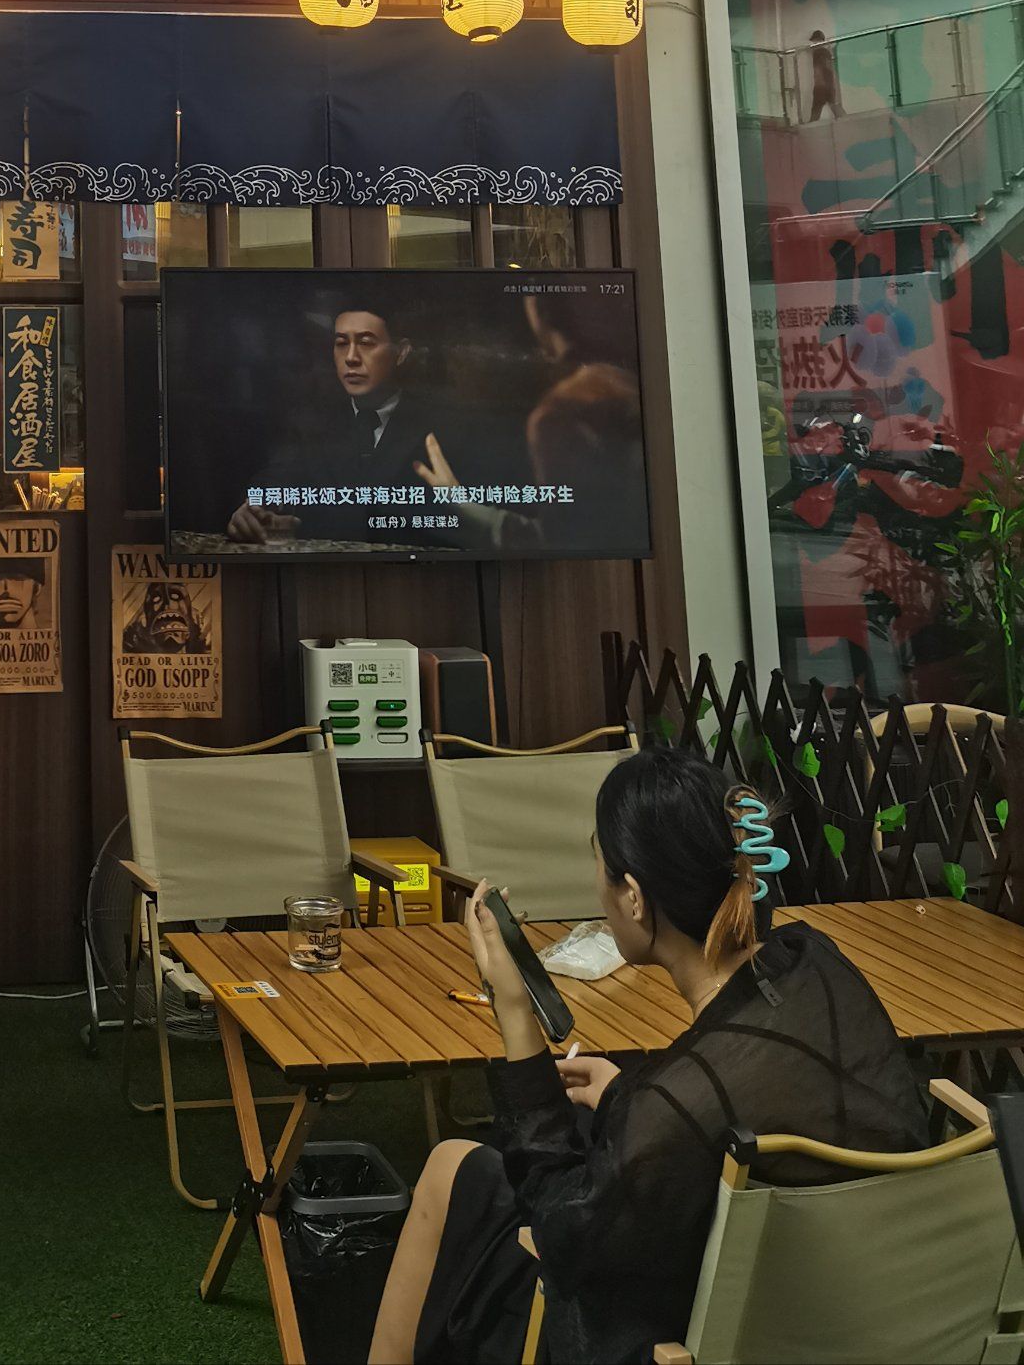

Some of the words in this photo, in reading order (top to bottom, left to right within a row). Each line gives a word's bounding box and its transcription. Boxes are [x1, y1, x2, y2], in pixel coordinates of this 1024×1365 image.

[7, 201, 44, 270] 寿司
[599, 284, 625, 294] 17:21
[8, 314, 43, 469] 和食居酒屋
[246, 486, 427, 506] 曾舜晞张颂文谍海过招
[432, 485, 574, 505] 双雄对峙险象环生
[412, 515, 459, 529] 悬疑谍战
[118, 553, 217, 580] WANTED
[19, 630, 54, 639] ALIVE
[19, 643, 49, 662] ZORO
[122, 657, 150, 665] DEAD
[158, 657, 172, 665] OR
[179, 656, 213, 665] ALIVE
[23, 676, 56, 686] MARINE
[125, 668, 156, 688] GOD
[163, 668, 210, 688] USOPP
[183, 701, 216, 712] MARINE
